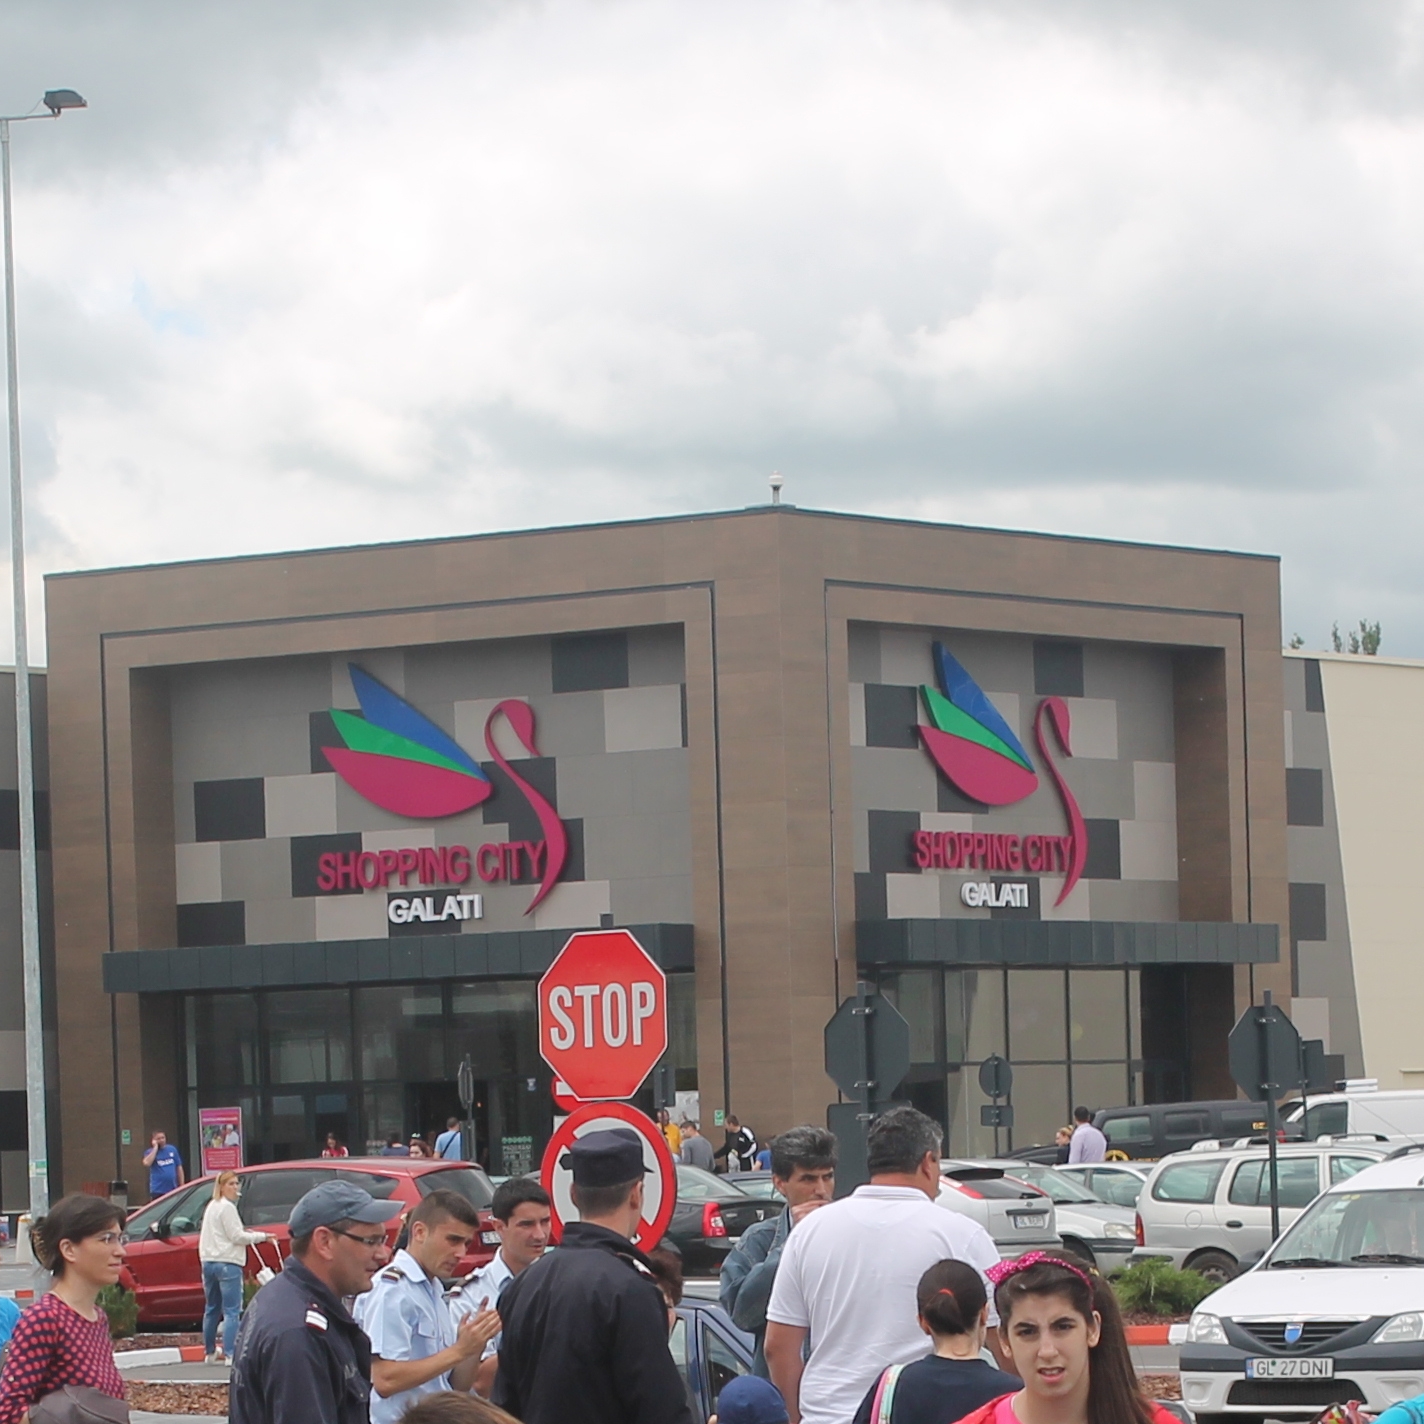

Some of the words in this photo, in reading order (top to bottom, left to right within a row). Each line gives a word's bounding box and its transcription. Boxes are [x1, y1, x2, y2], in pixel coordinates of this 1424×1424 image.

[317, 846, 472, 891] SHOPPING
[477, 840, 547, 881] CITY
[913, 830, 1022, 872] SHOPPING
[1022, 834, 1074, 873] CITY
[388, 894, 483, 924] GALATI
[960, 882, 1029, 909] GALATI
[549, 981, 657, 1051] STOP
[1256, 1360, 1274, 1376] GL
[1280, 1360, 1296, 1376] 27
[1300, 1359, 1329, 1376] DNI
